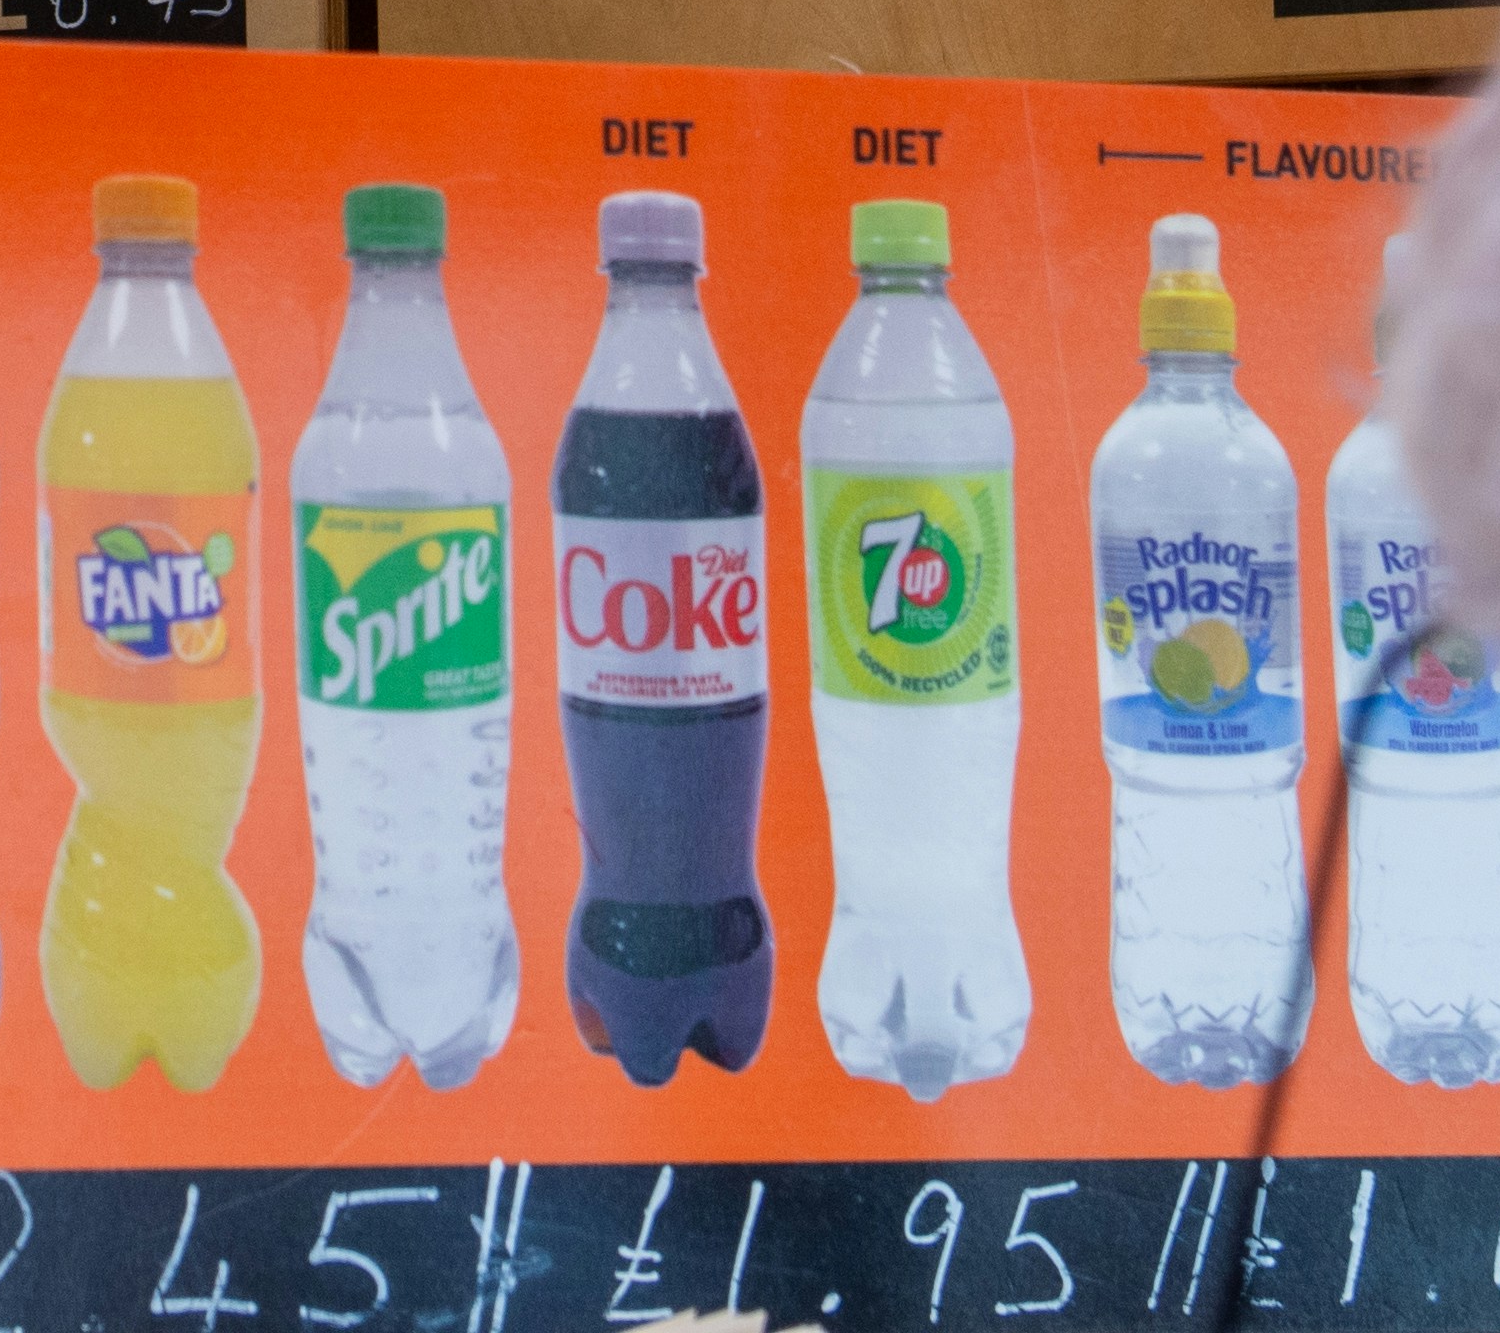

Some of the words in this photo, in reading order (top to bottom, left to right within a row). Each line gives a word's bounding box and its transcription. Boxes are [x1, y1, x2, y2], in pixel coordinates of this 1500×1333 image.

[601, 118, 694, 159] DIET
[852, 126, 942, 167] DIET
[1137, 531, 1258, 574] Radnor
[77, 555, 222, 623] FANTA
[320, 533, 494, 706] Sprite
[560, 544, 759, 653] Coke
[1125, 566, 1272, 629] splash
